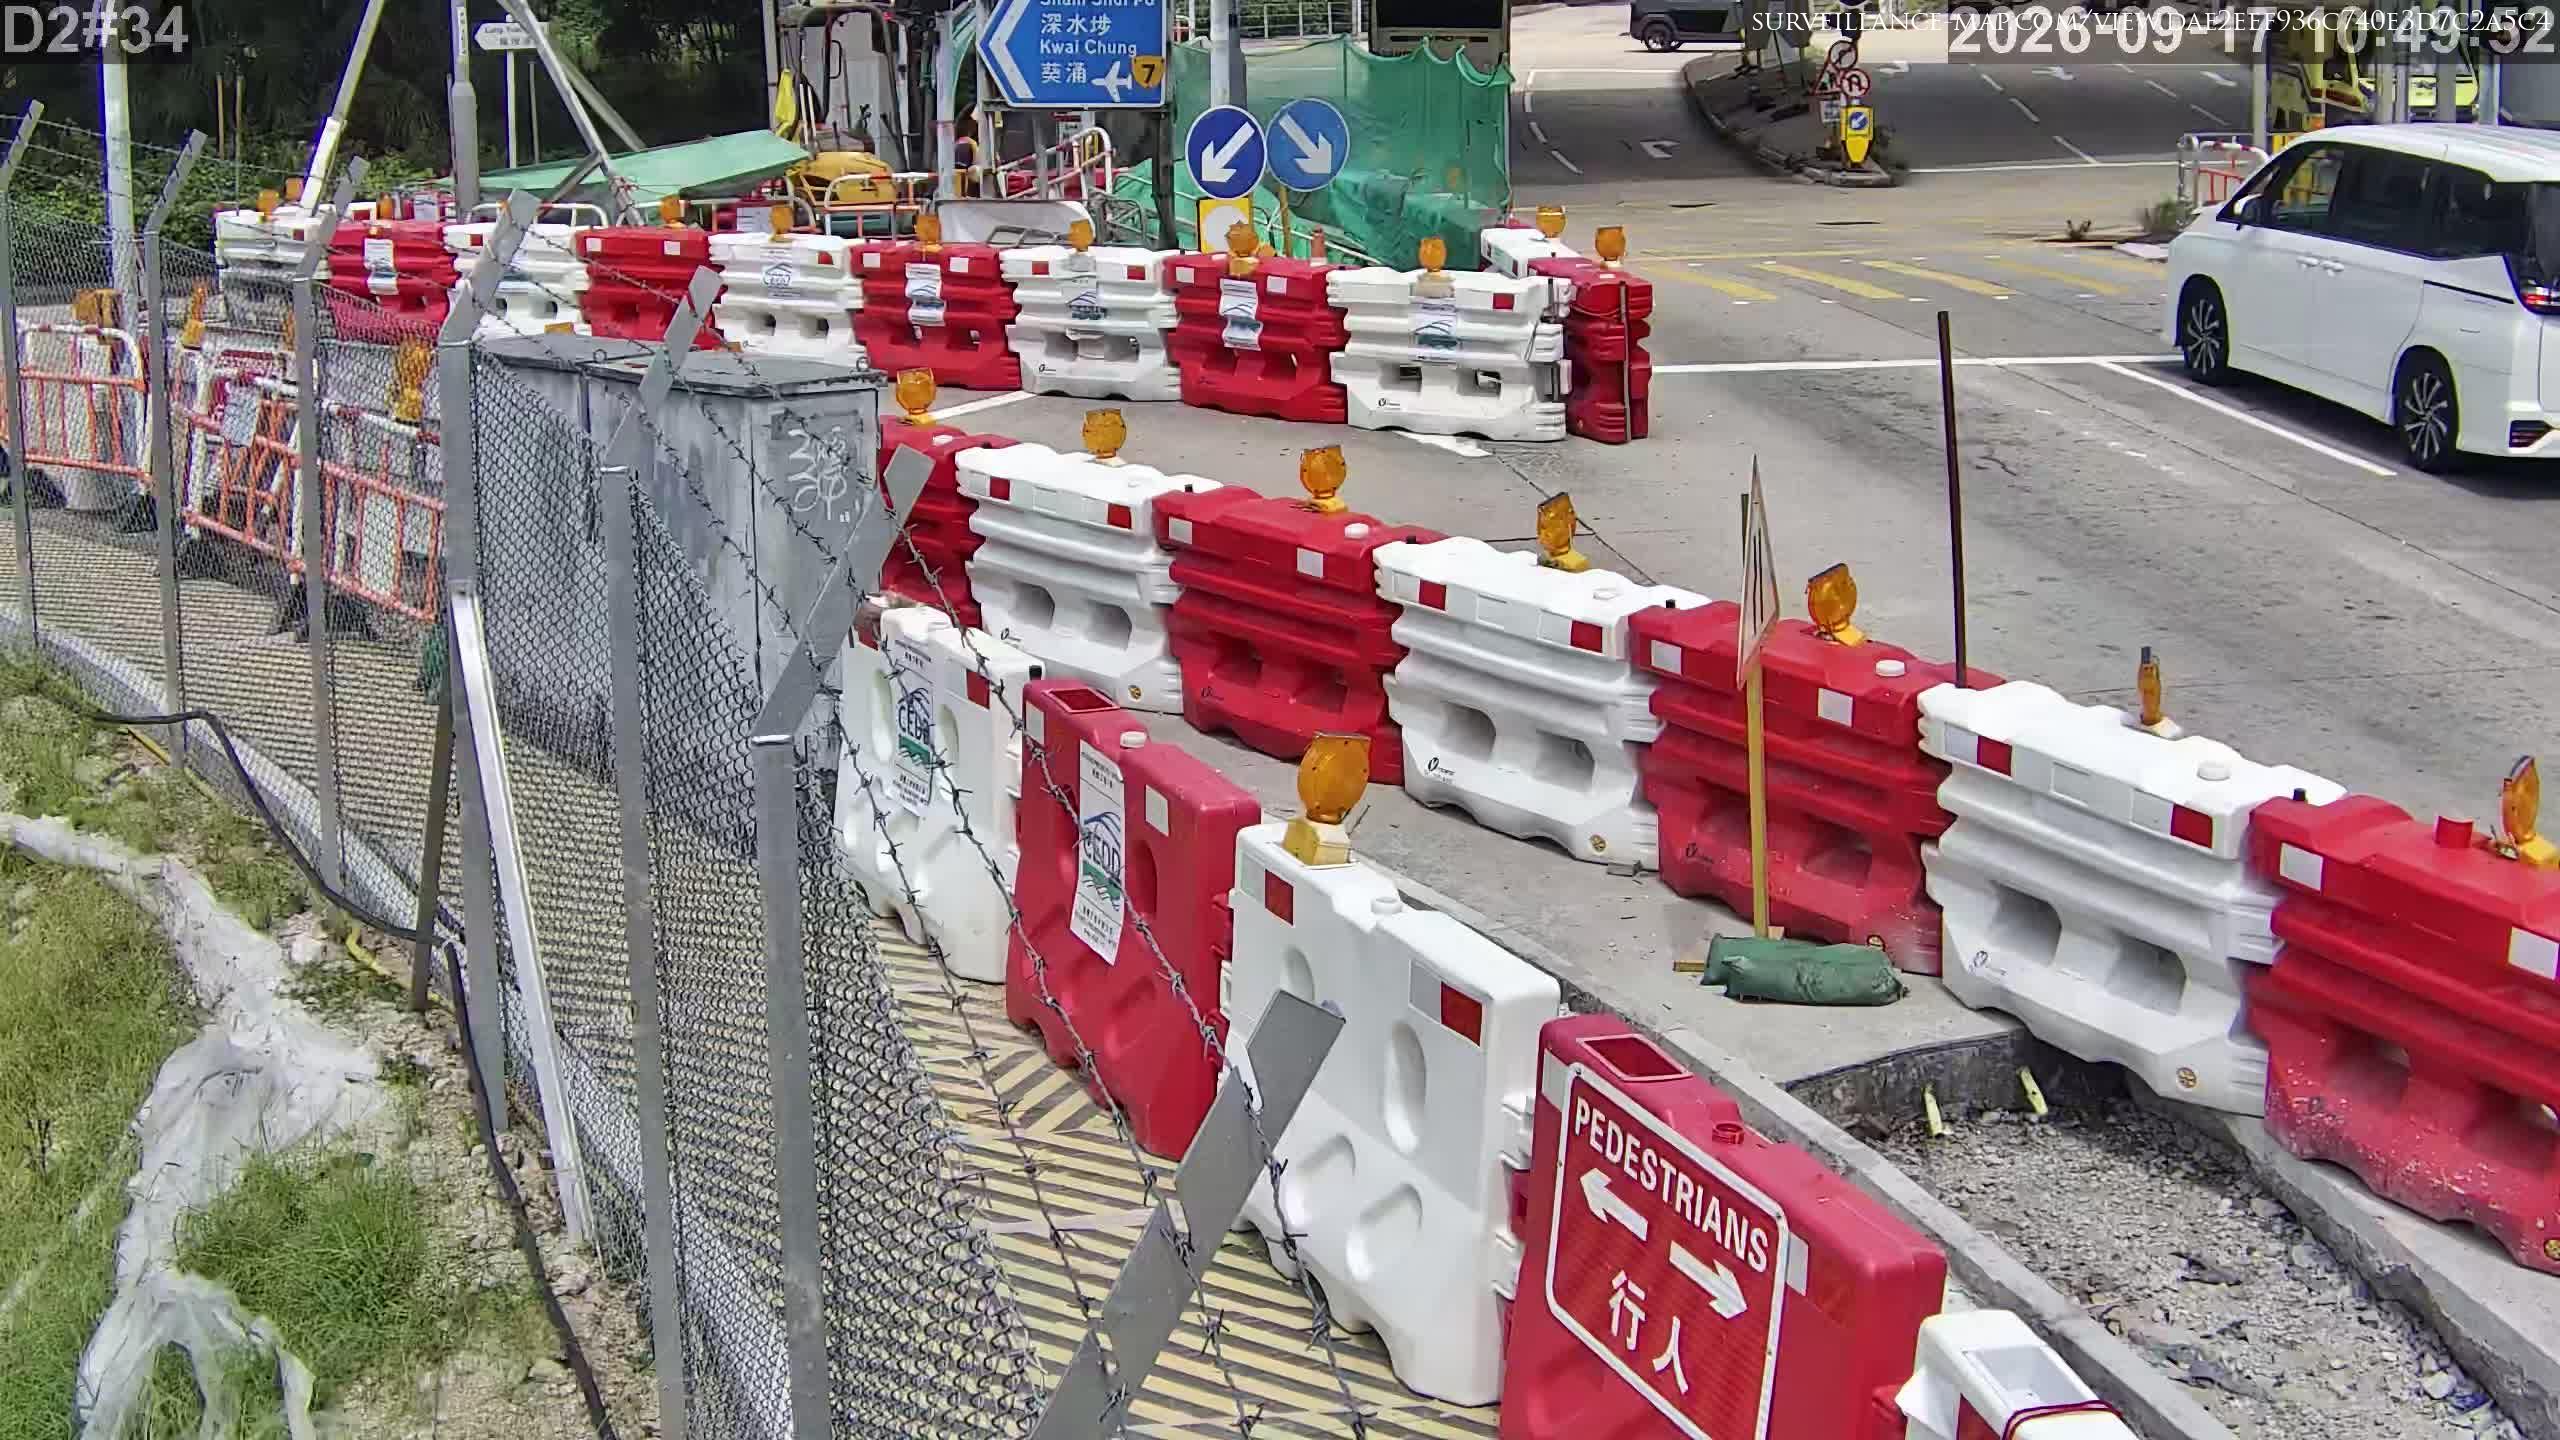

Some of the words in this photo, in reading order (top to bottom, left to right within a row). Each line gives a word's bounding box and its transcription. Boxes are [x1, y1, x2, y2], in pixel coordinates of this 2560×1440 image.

[1041, 13, 1113, 37] 深水埗
[1040, 40, 1079, 54] Kwai
[1084, 39, 1137, 57] Chung
[1041, 62, 1088, 83] 葵涌
[1141, 63, 1156, 84] 7
[1576, 1096, 1769, 1273] PEDESTRIANS
[1608, 1270, 1689, 1394] 行人
